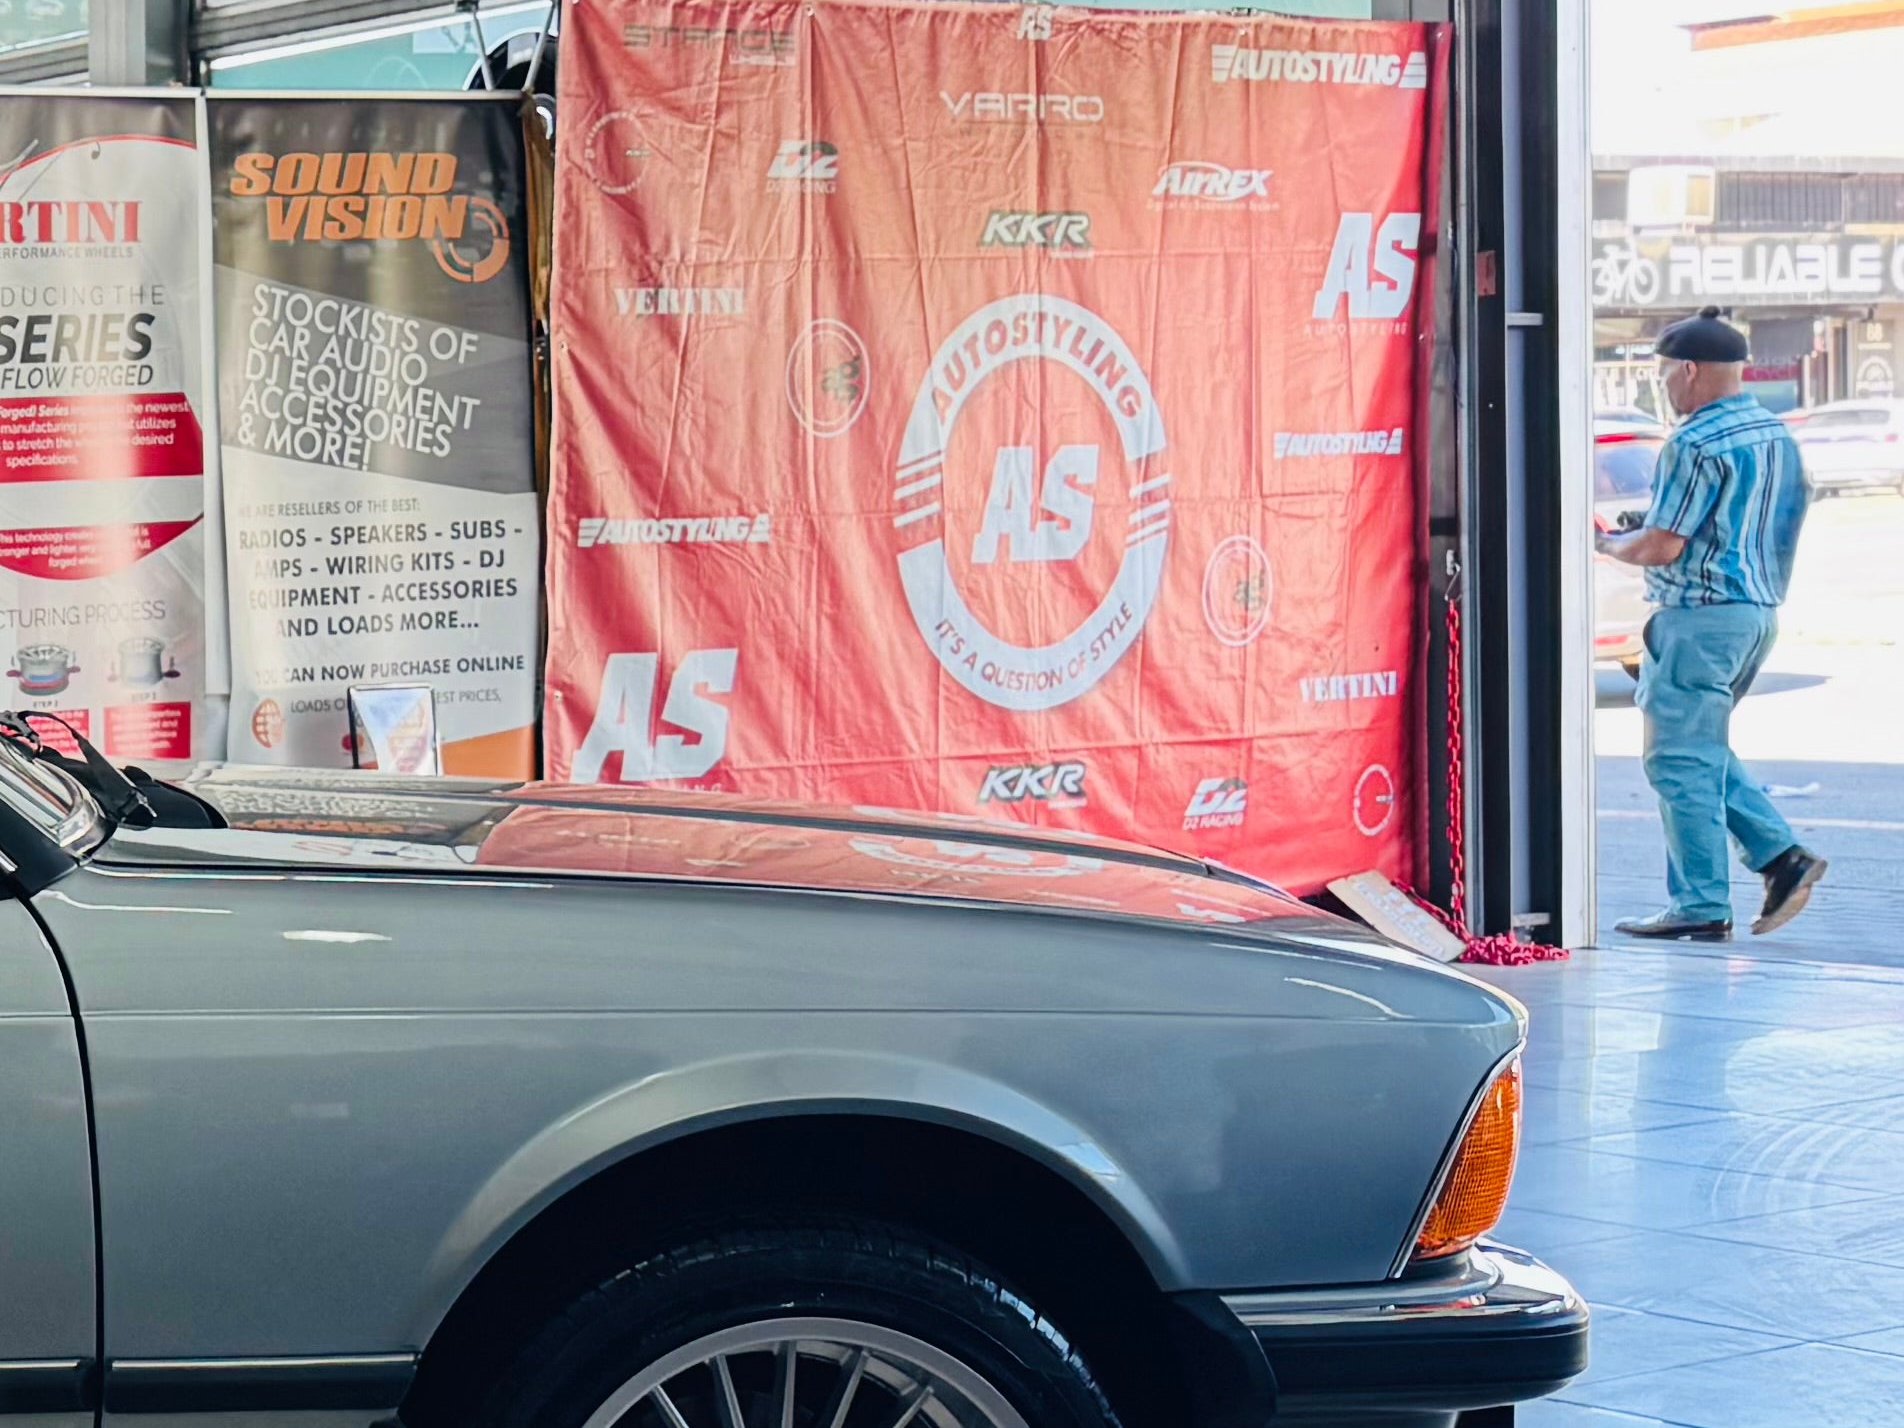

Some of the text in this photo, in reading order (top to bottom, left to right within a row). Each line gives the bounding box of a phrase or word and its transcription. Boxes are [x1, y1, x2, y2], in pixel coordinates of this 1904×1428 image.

[1016, 5, 1052, 40] AS
[1231, 48, 1402, 87] AUTOSTYLING
[940, 90, 1105, 123] VARRO
[229, 152, 458, 196] SOUND
[767, 139, 839, 179] D2
[265, 194, 469, 241] VISION
[979, 209, 1091, 249] KKR
[84, 245, 133, 259] WHEELS
[1312, 212, 1422, 320] AS
[1669, 243, 1883, 295] RELIABLE
[114, 284, 166, 306] THE
[613, 287, 745, 317] VERTINI
[252, 283, 480, 365] STOCKISTS OF
[248, 317, 428, 387] CAR AUDIO
[932, 311, 1143, 424] AUTOSTYLING
[0, 366, 68, 391] FLOW
[71, 364, 154, 388] FORGED
[245, 349, 482, 430] DJ EQUIPMENT
[239, 386, 453, 458] ACCESSORIES
[238, 415, 372, 471] & MORE!
[277, 500, 341, 517] RESELLERS
[345, 500, 364, 515] OF
[367, 499, 389, 514] THE
[971, 444, 1100, 564] AS
[239, 519, 507, 550] RADIOS SPEAKERS SUBS
[597, 518, 750, 546] AUTOSTYLING
[254, 549, 506, 579] AMPS WIRING KITS DJ
[85, 599, 166, 625] PROCESS
[249, 577, 518, 610] EQUIPMENT ACCESSORIES
[276, 617, 319, 638] AND
[326, 613, 394, 636] LOADS
[934, 601, 1133, 693] IT'S QUESTION OF STYLE
[284, 654, 526, 684] CAN NOW PURCHASE ONLINE
[1299, 670, 1397, 703] VERTINI
[291, 698, 331, 714] LOADS
[569, 648, 739, 785] AS
[978, 760, 1087, 803] KKR
[1186, 777, 1248, 817] D2
[1200, 813, 1243, 829] RACING
